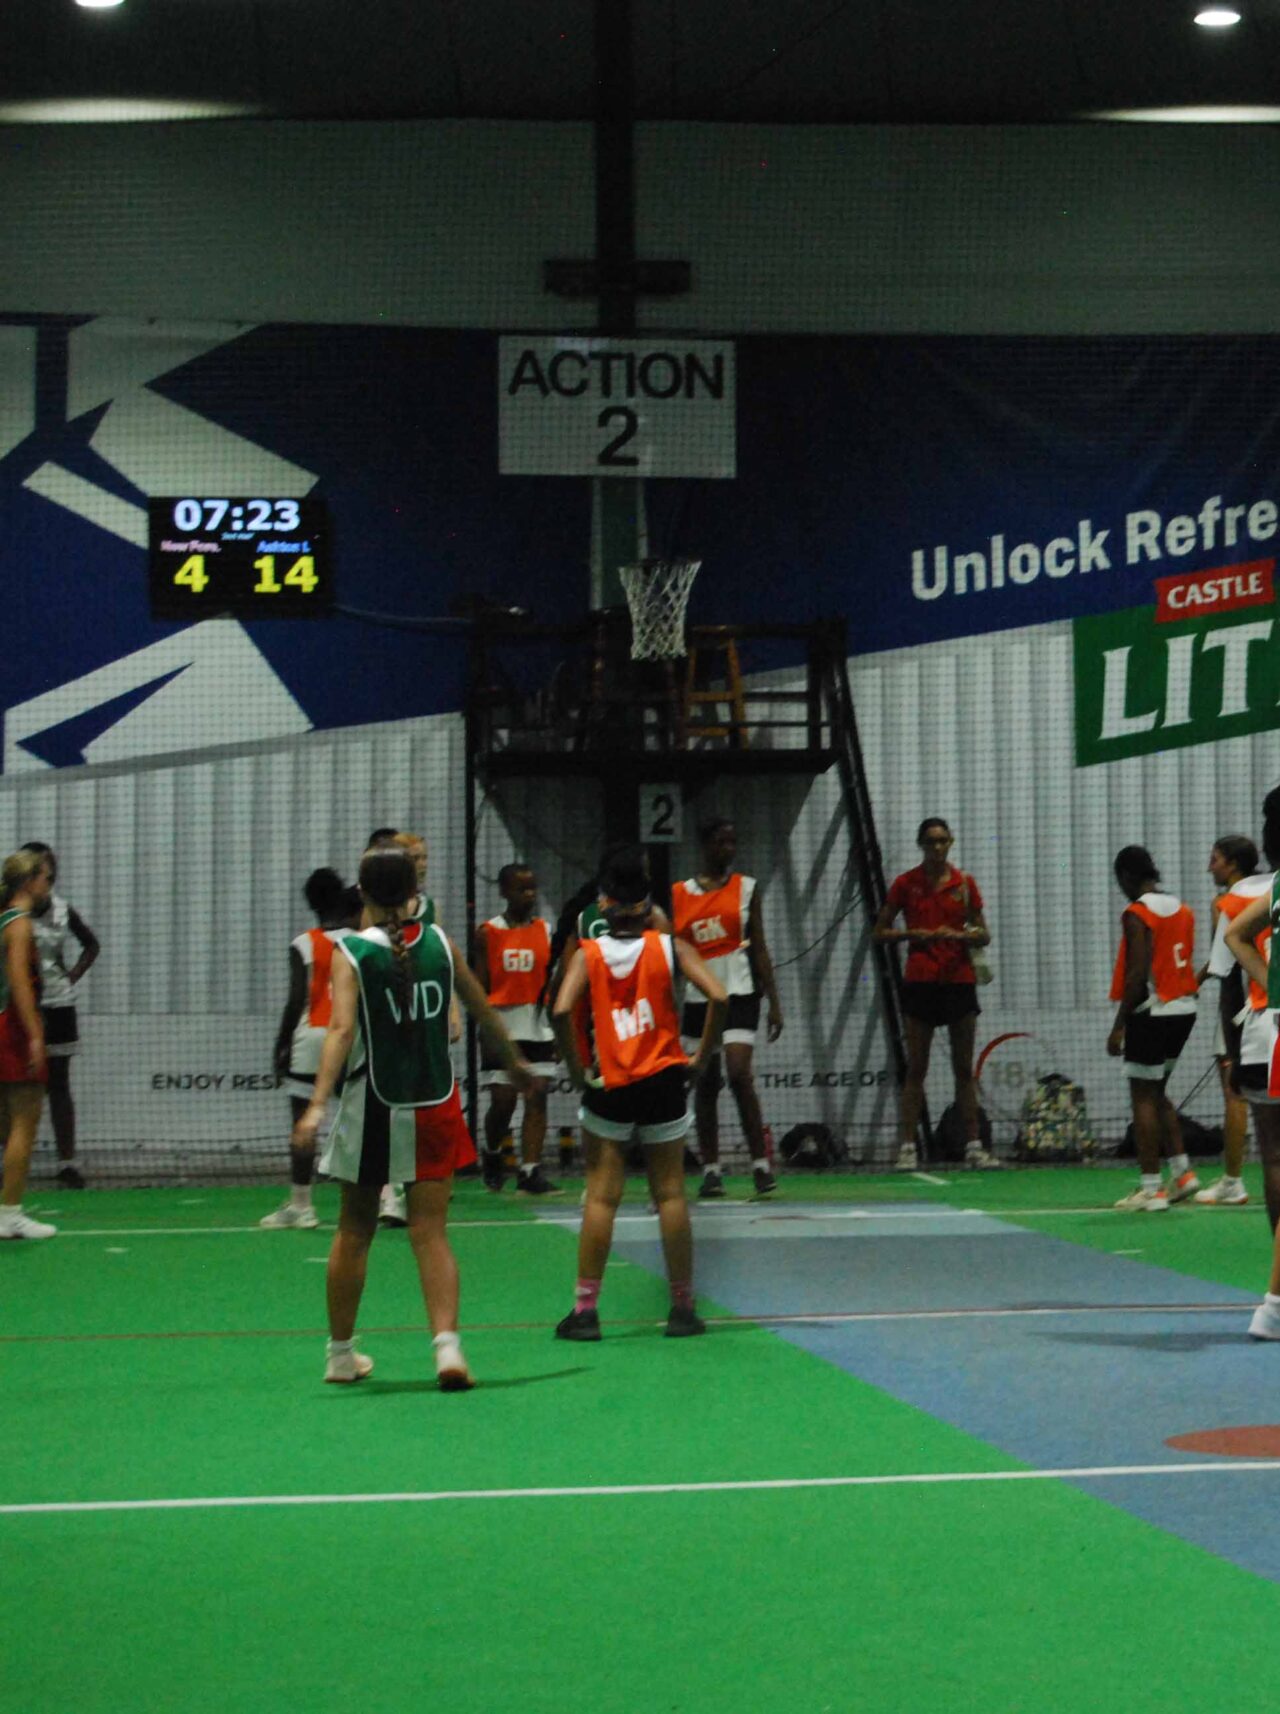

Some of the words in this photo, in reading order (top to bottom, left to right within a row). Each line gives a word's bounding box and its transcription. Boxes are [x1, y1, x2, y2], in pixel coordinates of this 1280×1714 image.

[508, 349, 724, 399] ACTION
[598, 405, 640, 467] 2
[174, 499, 301, 532] 07:23
[174, 555, 210, 593] 4
[253, 555, 319, 594] 14
[911, 519, 1114, 600] Unlock
[1166, 570, 1264, 610] CASTLE
[652, 794, 674, 835] 2
[691, 915, 728, 944] GK
[611, 997, 656, 1042] WA
[152, 1074, 225, 1090] ENJOY
[232, 1074, 285, 1090] RES
[759, 1072, 802, 1088] THE
[809, 1071, 854, 1087] AGE
[859, 1070, 889, 1086] OF
